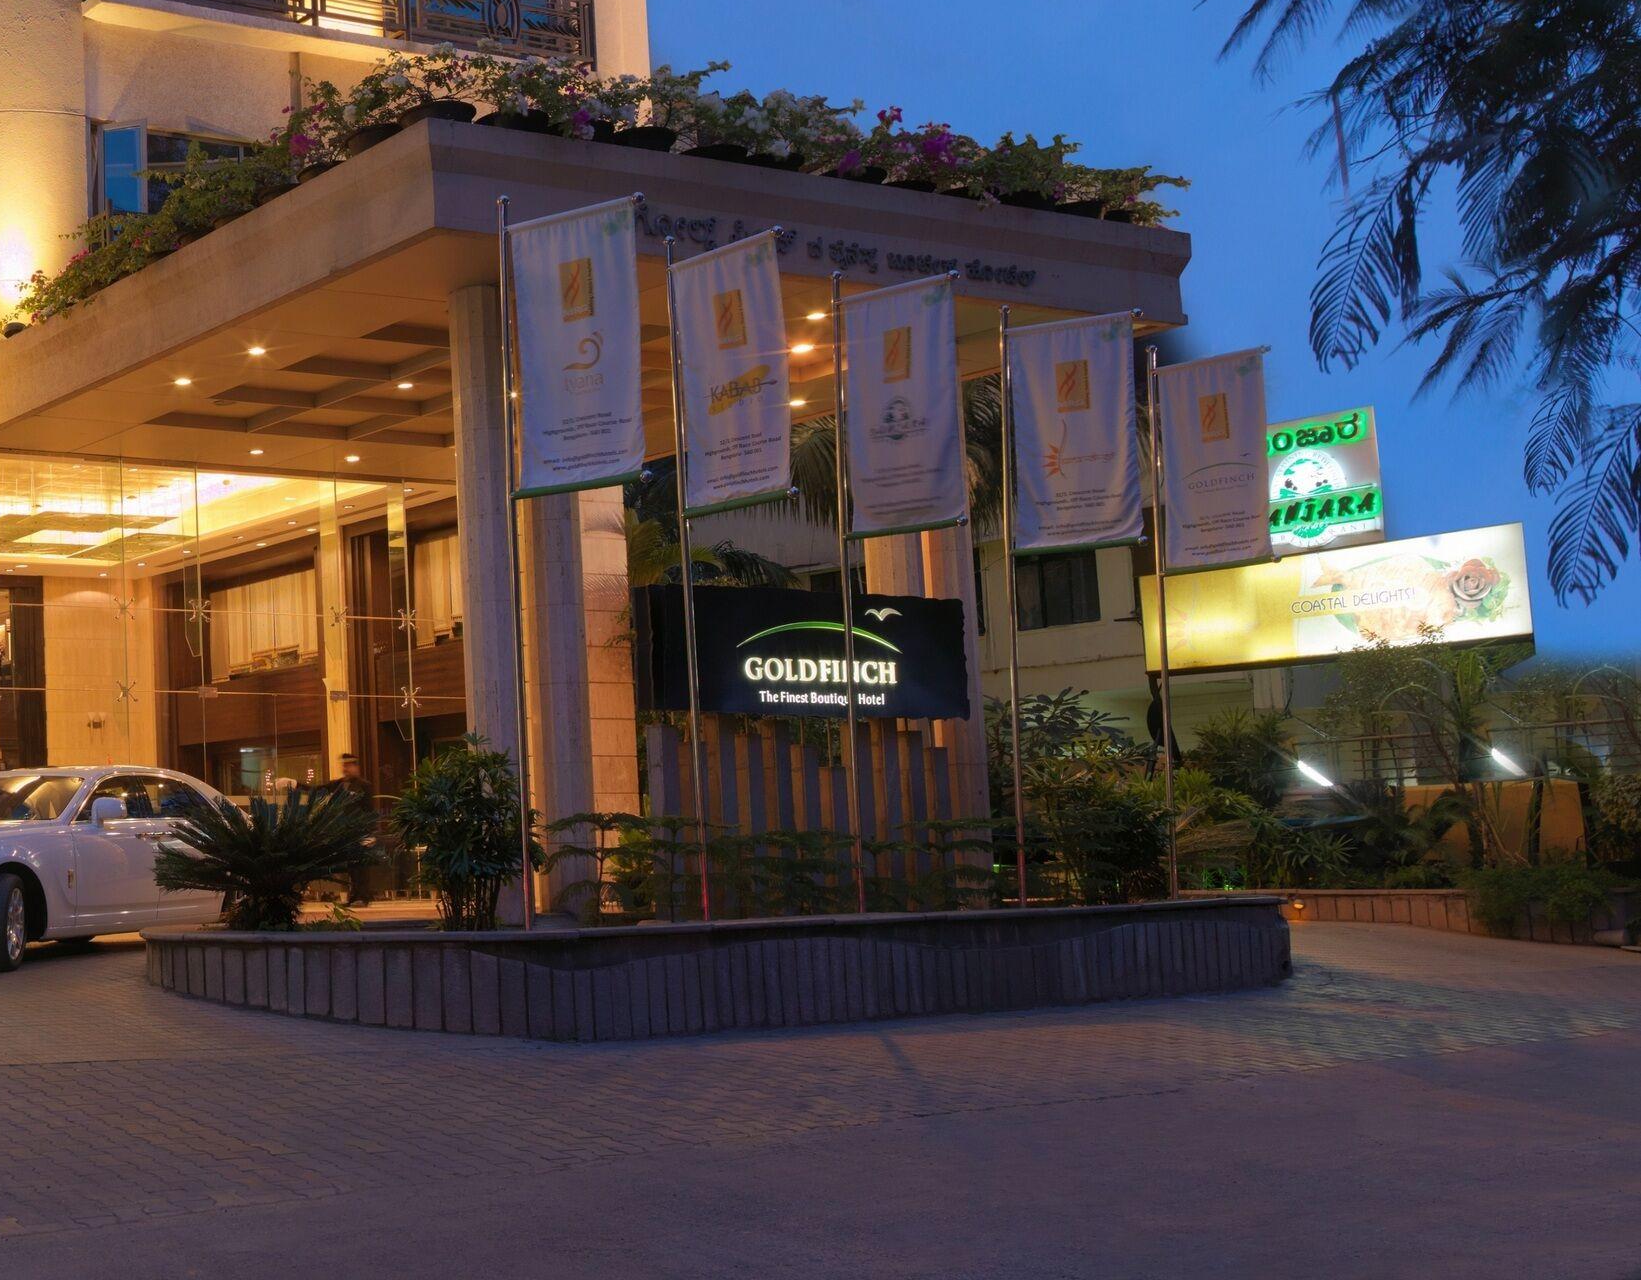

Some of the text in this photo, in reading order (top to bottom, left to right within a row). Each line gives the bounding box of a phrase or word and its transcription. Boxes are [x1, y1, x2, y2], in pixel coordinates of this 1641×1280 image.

[1267, 412, 1359, 452] ಂಜಾರ
[1188, 471, 1256, 490] GOLDFINCH
[1269, 493, 1376, 527] ANJARA
[1291, 587, 1416, 614] COASTAL DELIGHTS!
[744, 656, 898, 685] GOLDFINCH
[759, 690, 885, 707] The Finest Boutiqu Hotel
